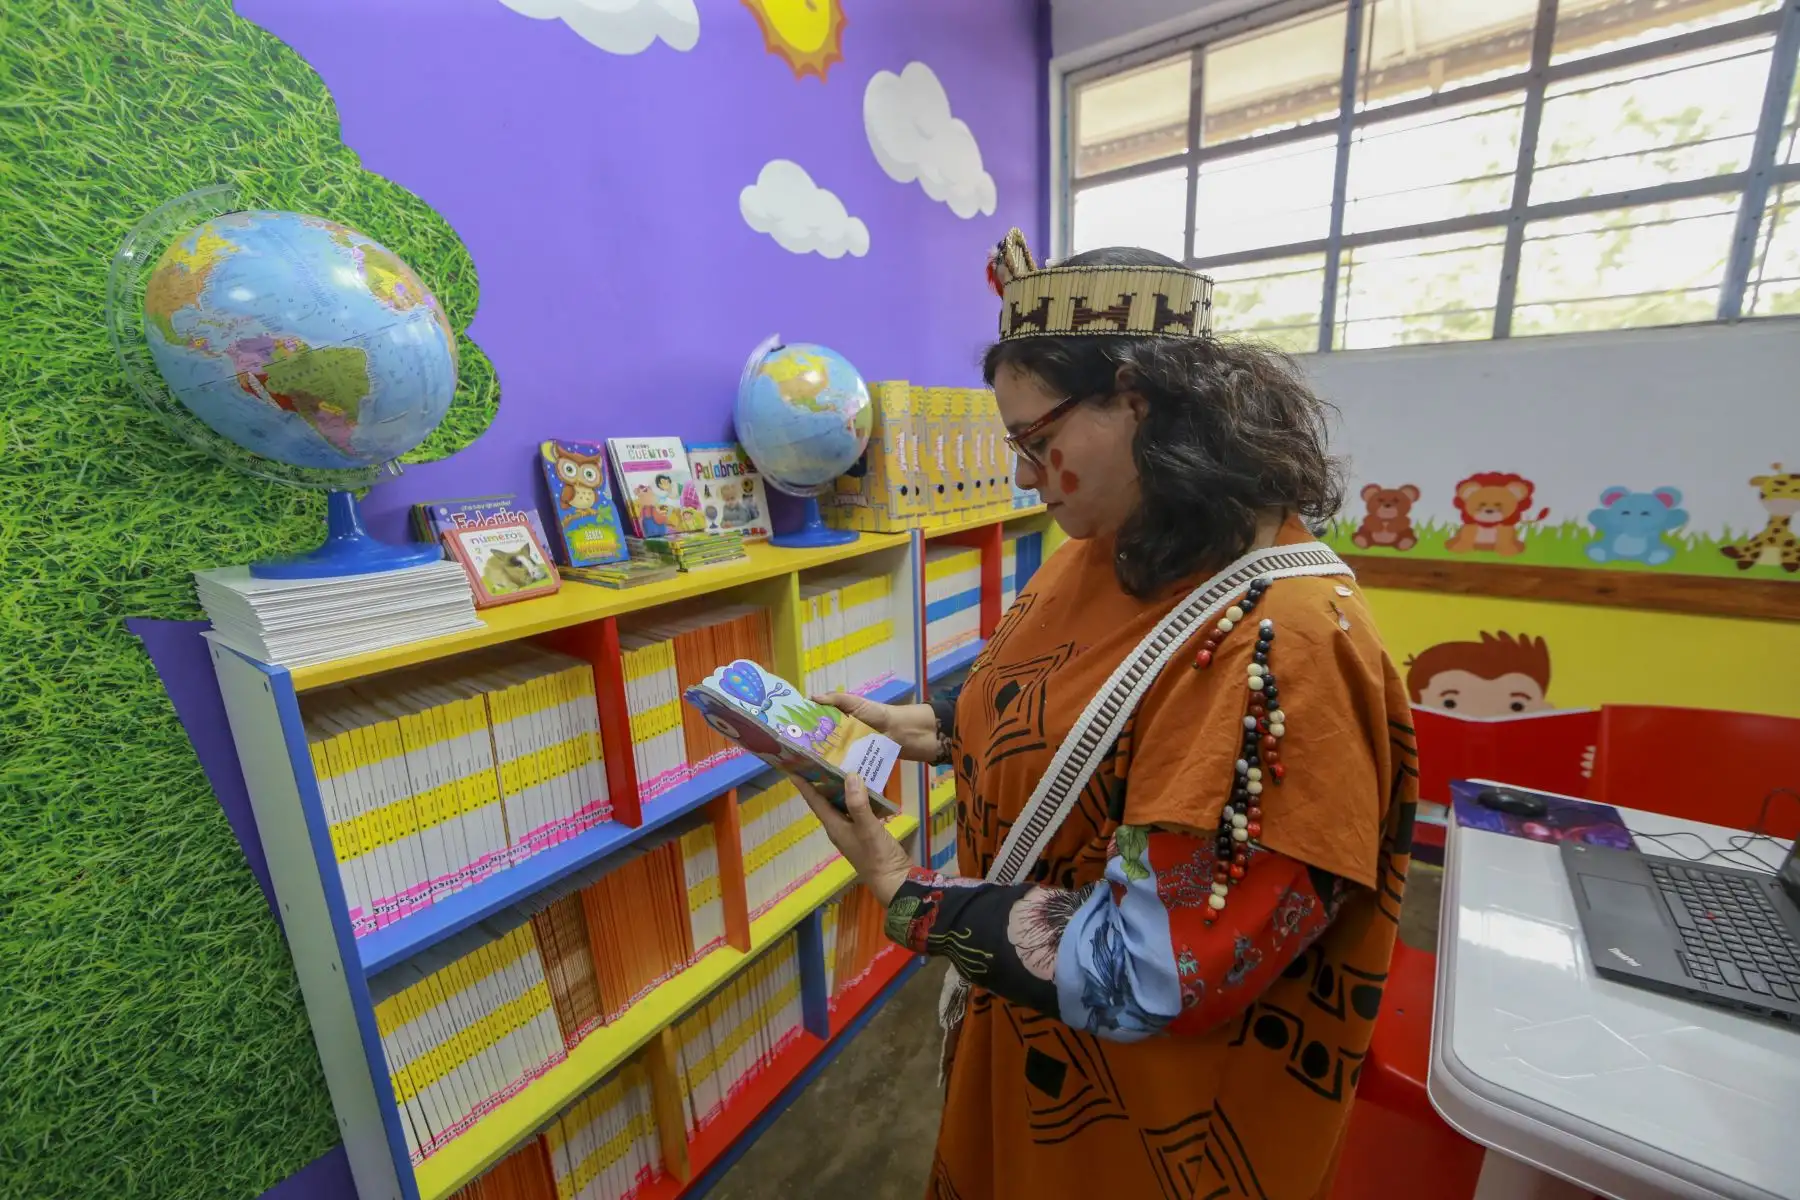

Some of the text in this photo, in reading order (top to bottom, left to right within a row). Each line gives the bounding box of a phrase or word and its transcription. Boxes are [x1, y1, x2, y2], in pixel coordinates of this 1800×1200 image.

[628, 447, 676, 460] CUENTOS
[695, 460, 745, 480] Palabras
[451, 507, 529, 530] Federico
